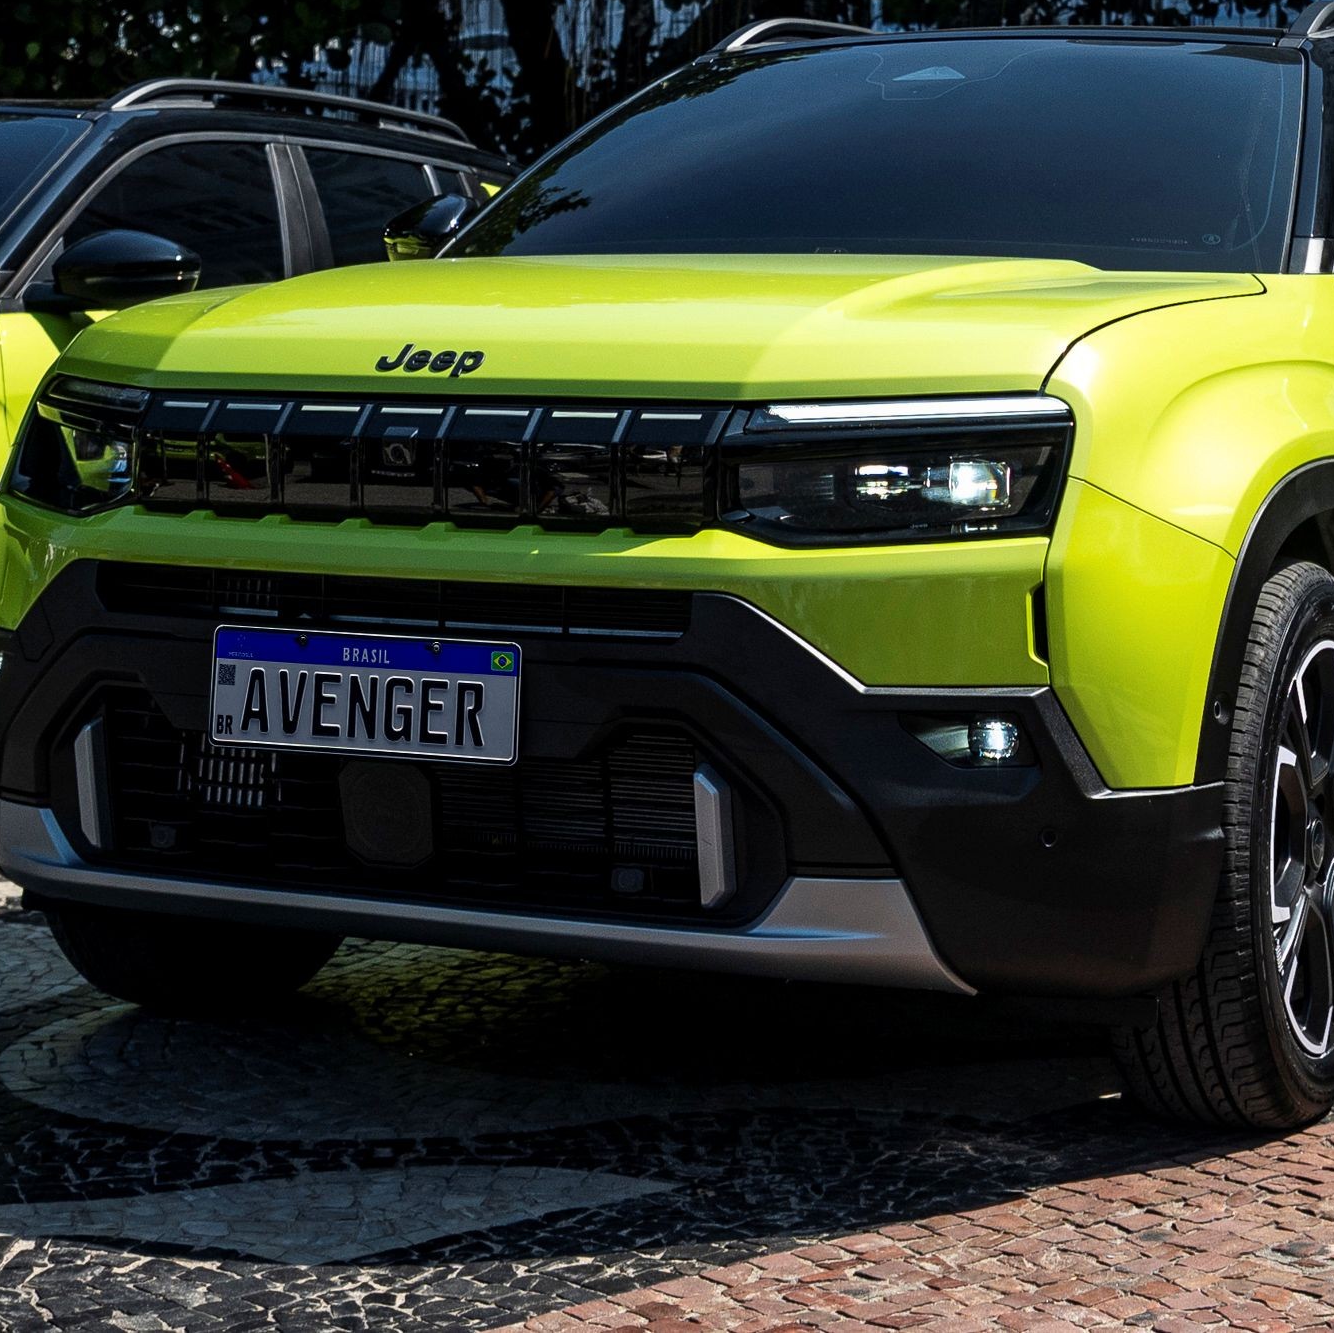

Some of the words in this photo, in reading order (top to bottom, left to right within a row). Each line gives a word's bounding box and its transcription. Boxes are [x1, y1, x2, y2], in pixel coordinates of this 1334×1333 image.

[375, 343, 486, 379] Jeep
[342, 647, 391, 665] BRASIL
[239, 667, 486, 748] AVENGER
[216, 714, 234, 737] BR
